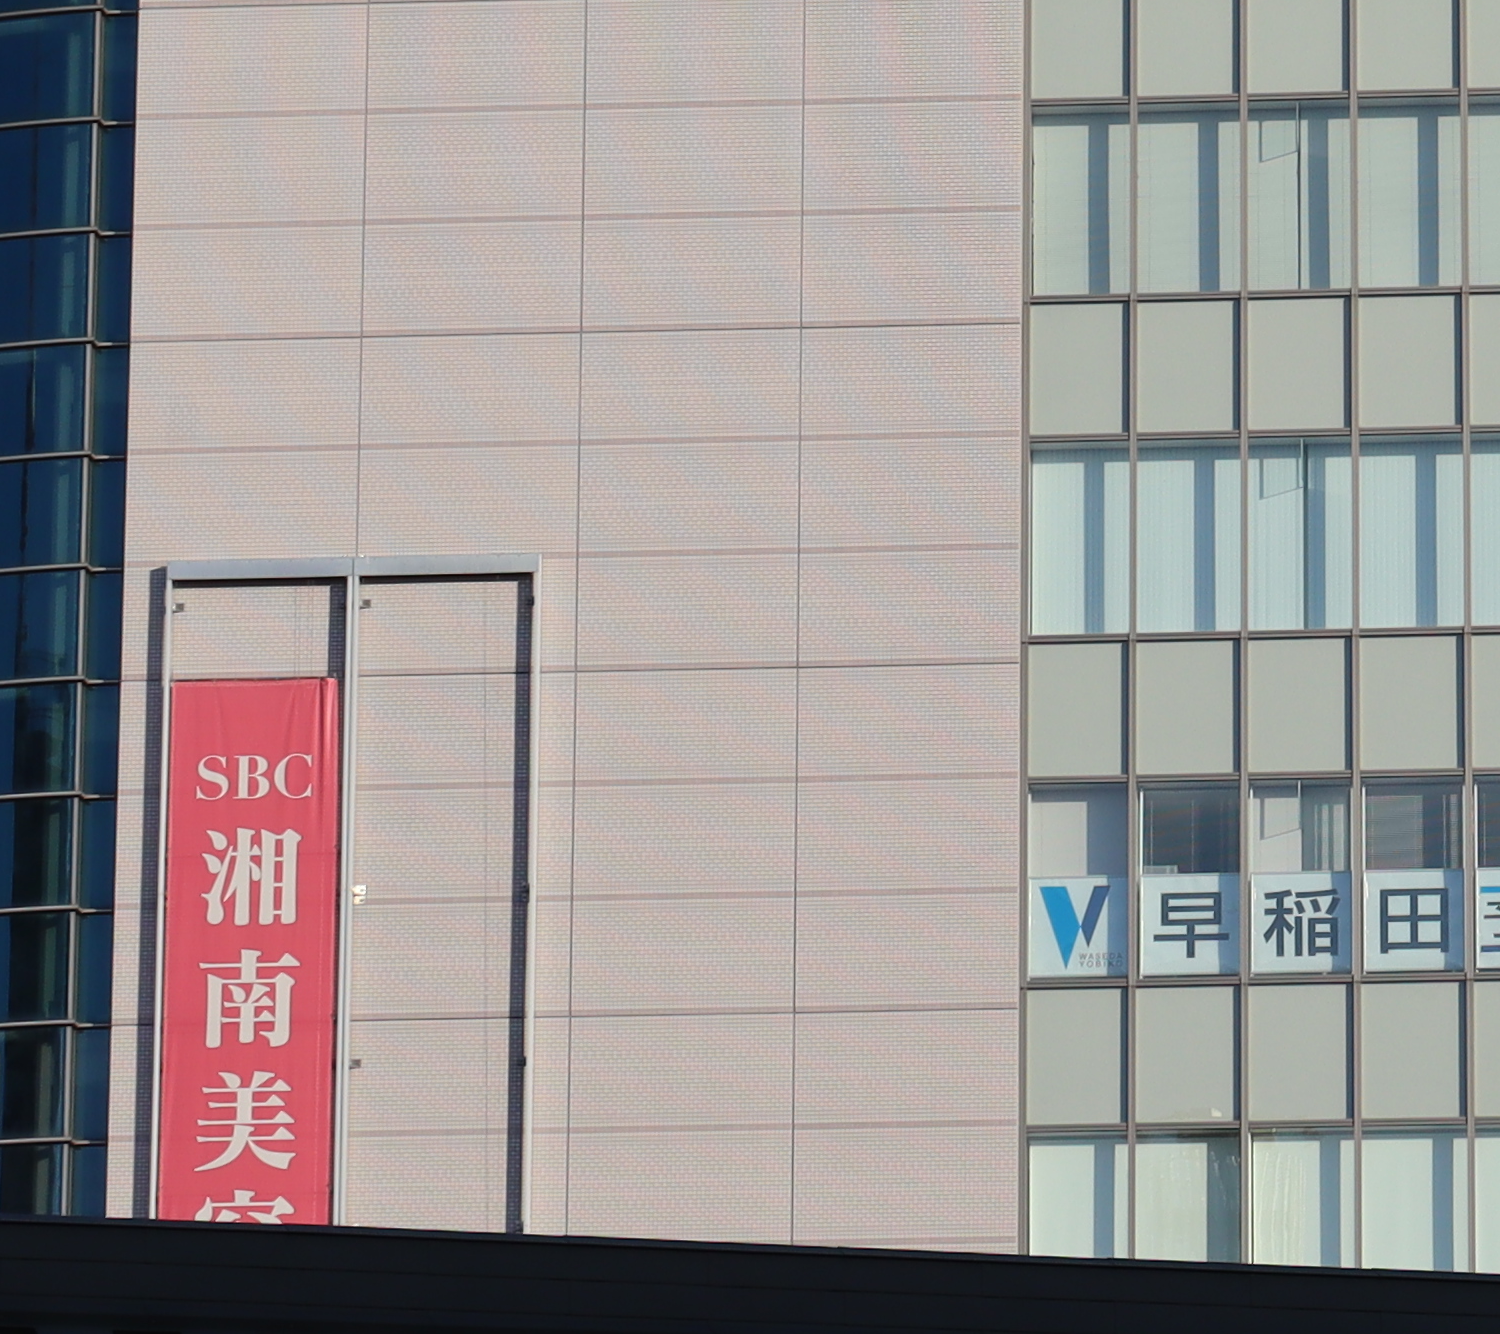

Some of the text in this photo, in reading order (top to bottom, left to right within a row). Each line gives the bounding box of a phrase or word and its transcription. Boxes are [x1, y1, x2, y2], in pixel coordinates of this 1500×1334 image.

[194, 753, 314, 801] SBC
[1079, 952, 1123, 960] WASEDA
[1079, 960, 1123, 968] YOBIKO
